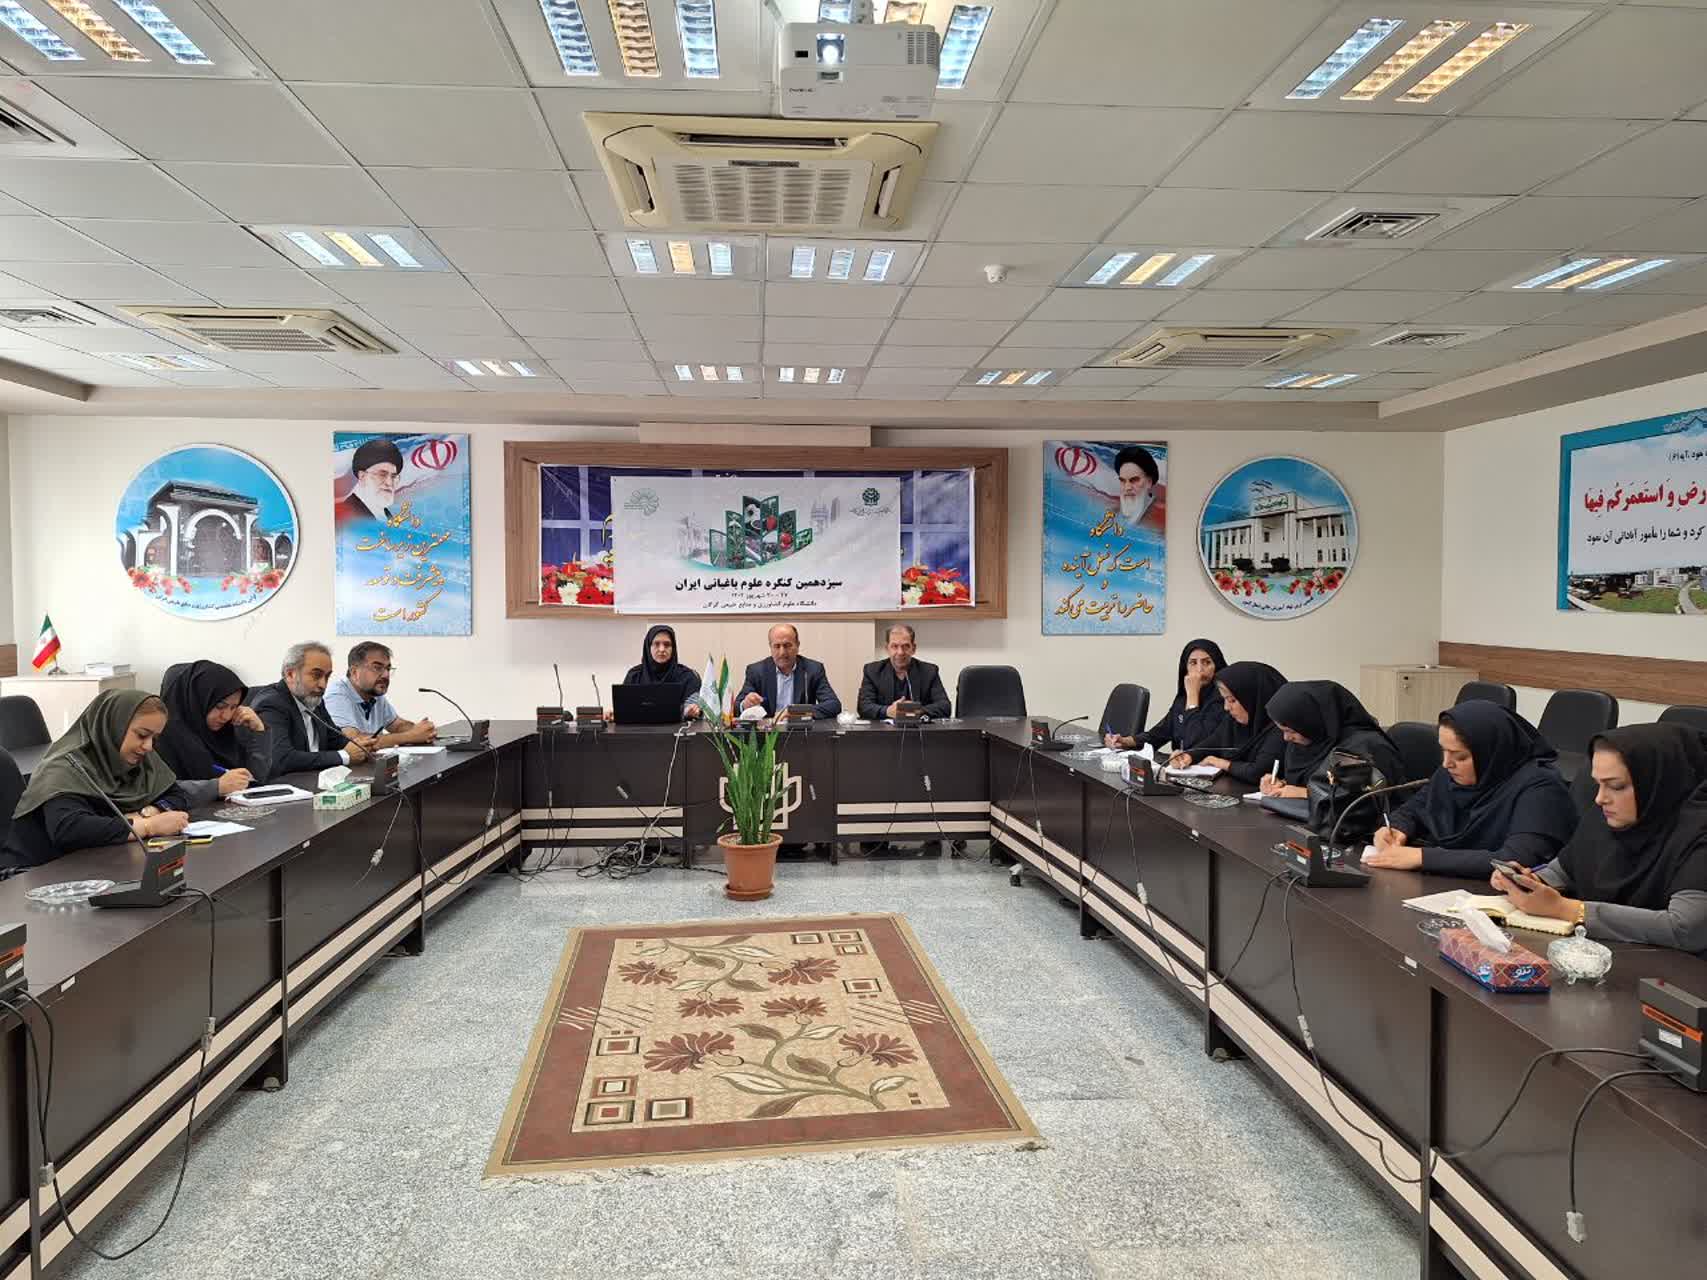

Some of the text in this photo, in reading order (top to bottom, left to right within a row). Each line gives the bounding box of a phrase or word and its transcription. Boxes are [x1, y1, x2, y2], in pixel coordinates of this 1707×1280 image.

[1660, 528, 1667, 541] را
[1667, 527, 1680, 538] شما
[1683, 529, 1688, 540] و
[675, 577, 843, 591] سیزدهمین کنگره علوم باغبانی ایران
[758, 600, 781, 609] کشاورزی
[783, 600, 795, 608] علوم
[796, 600, 817, 608] دانشگاه
